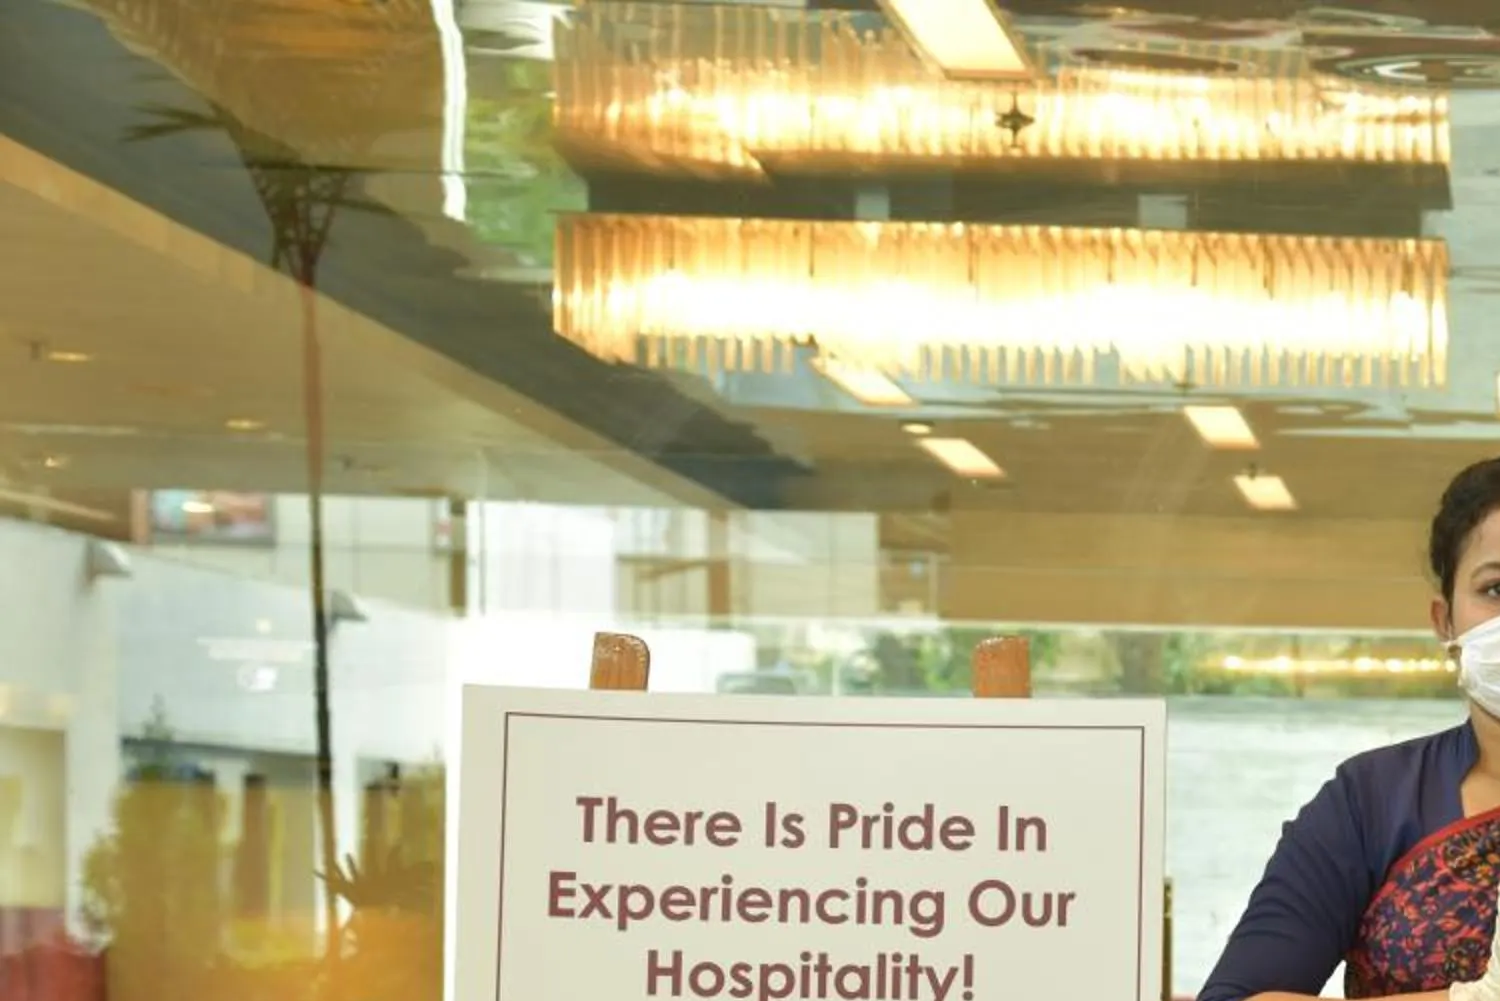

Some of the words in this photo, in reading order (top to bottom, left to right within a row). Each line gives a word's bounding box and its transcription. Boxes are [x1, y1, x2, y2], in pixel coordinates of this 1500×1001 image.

[577, 796, 742, 848] There
[765, 801, 806, 850] Is
[829, 804, 975, 852] Pride
[998, 806, 1048, 851] In
[548, 872, 945, 938] Experiencing
[968, 879, 1076, 927] Our
